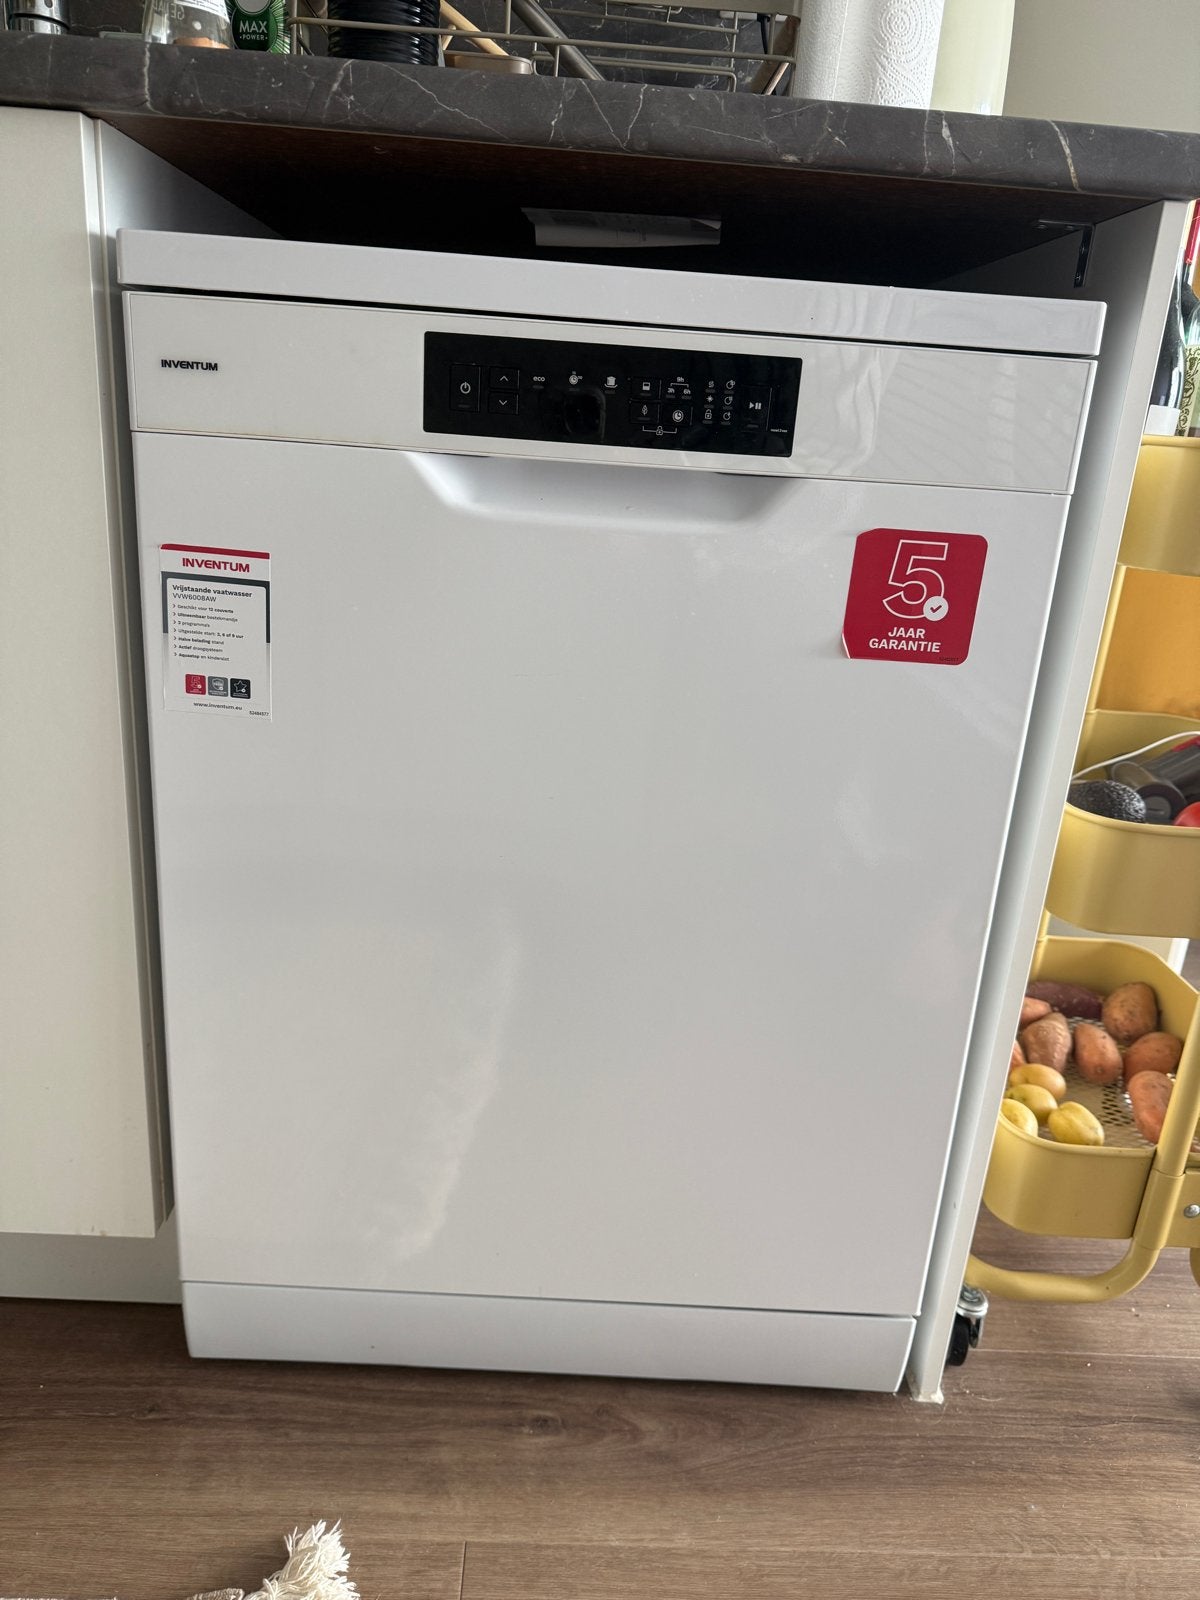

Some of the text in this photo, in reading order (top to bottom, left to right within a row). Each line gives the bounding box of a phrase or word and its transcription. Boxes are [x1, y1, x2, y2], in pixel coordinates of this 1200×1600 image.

[239, 20, 268, 33] MAX
[160, 359, 219, 371] INVENTUM
[532, 375, 546, 383] eco
[182, 557, 251, 573] INVENTUM
[882, 539, 949, 619] 5
[172, 584, 253, 598] Vrijstaande vaatwasser
[177, 603, 197, 611] Geschikt
[177, 612, 207, 620] Uitneembaar
[178, 627, 203, 636] Uitgestelde
[888, 626, 926, 639] JAAR
[191, 637, 211, 645] belading
[868, 637, 942, 653] GARANTIE
[193, 701, 243, 711] www.inventum.eu
